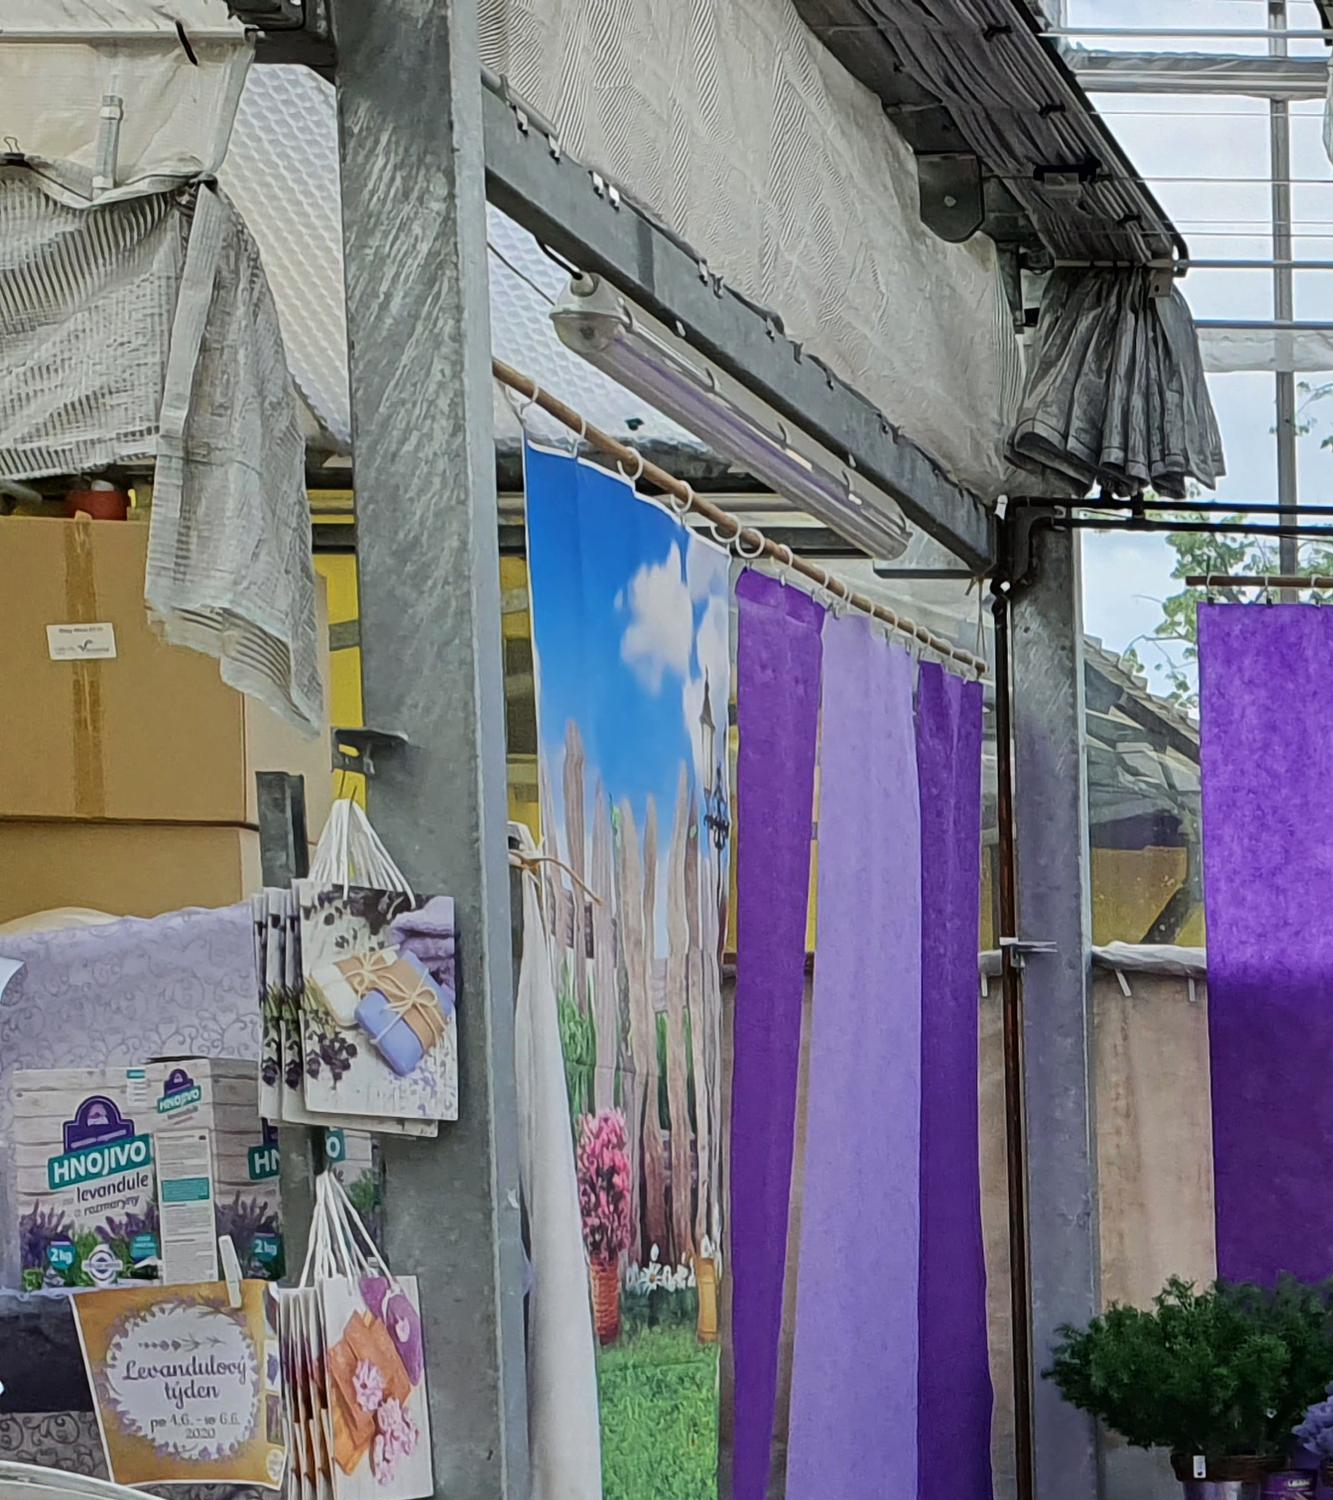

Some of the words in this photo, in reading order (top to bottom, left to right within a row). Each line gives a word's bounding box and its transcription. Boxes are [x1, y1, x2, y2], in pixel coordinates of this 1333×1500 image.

[53, 1140, 147, 1184] HNOJIVO
[77, 1171, 149, 1203] levandule
[121, 1353, 246, 1386] Levandulový
[164, 1378, 220, 1410] týden
[185, 1427, 216, 1440] 2020
